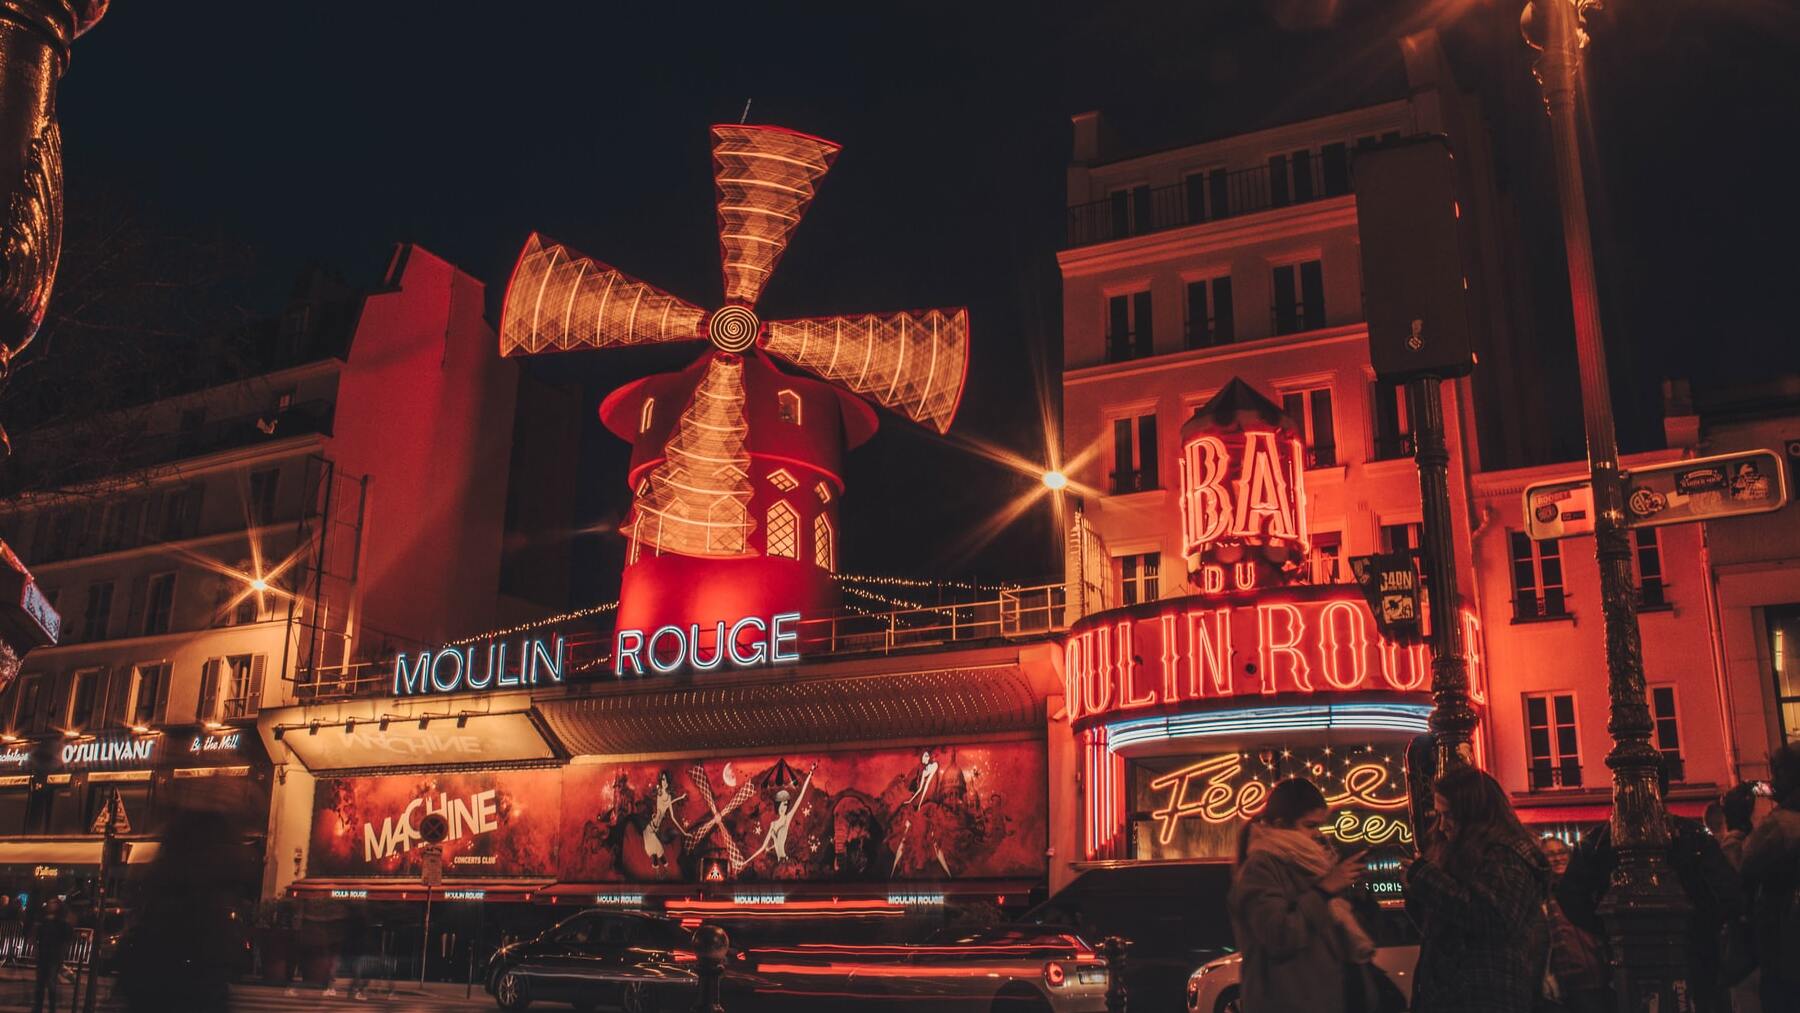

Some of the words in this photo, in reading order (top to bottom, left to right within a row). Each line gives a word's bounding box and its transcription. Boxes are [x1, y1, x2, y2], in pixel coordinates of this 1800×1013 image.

[1204, 563, 1255, 593] DU
[394, 636, 565, 696] MOULIN
[615, 611, 800, 677] ROUGE
[1066, 610, 1232, 723] OULIN
[1258, 600, 1484, 706] ROUE
[364, 790, 498, 862] MACHINE
[454, 856, 481, 864] CONCERTS
[482, 856, 496, 864] CLUB
[734, 896, 759, 904] MOULIN
[888, 896, 916, 904] MOULIN
[918, 896, 944, 904] ROUGE
